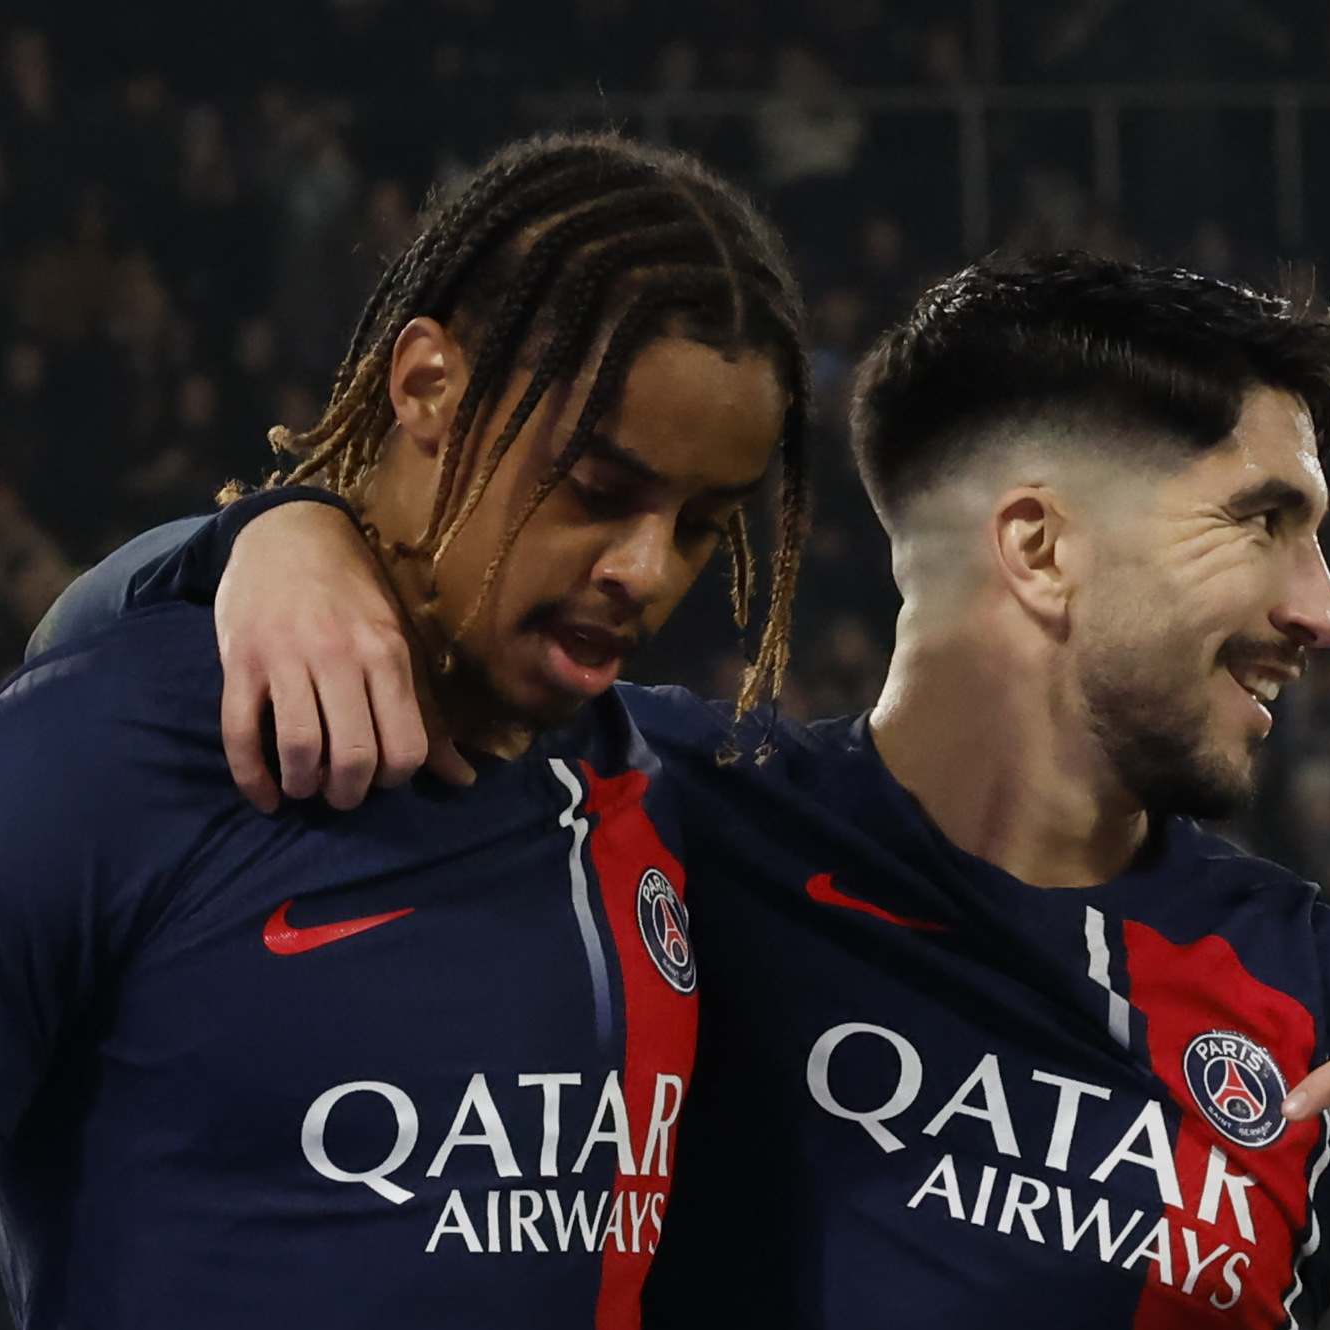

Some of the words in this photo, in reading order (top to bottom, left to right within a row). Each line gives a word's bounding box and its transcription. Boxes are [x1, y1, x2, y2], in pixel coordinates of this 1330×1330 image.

[1195, 1039, 1264, 1072] PARIS
[300, 1069, 684, 1205] QATAR
[806, 1021, 1259, 1246] QATAR
[424, 1188, 665, 1254] AIRWAYS
[906, 1153, 1251, 1310] AIRWAYS
